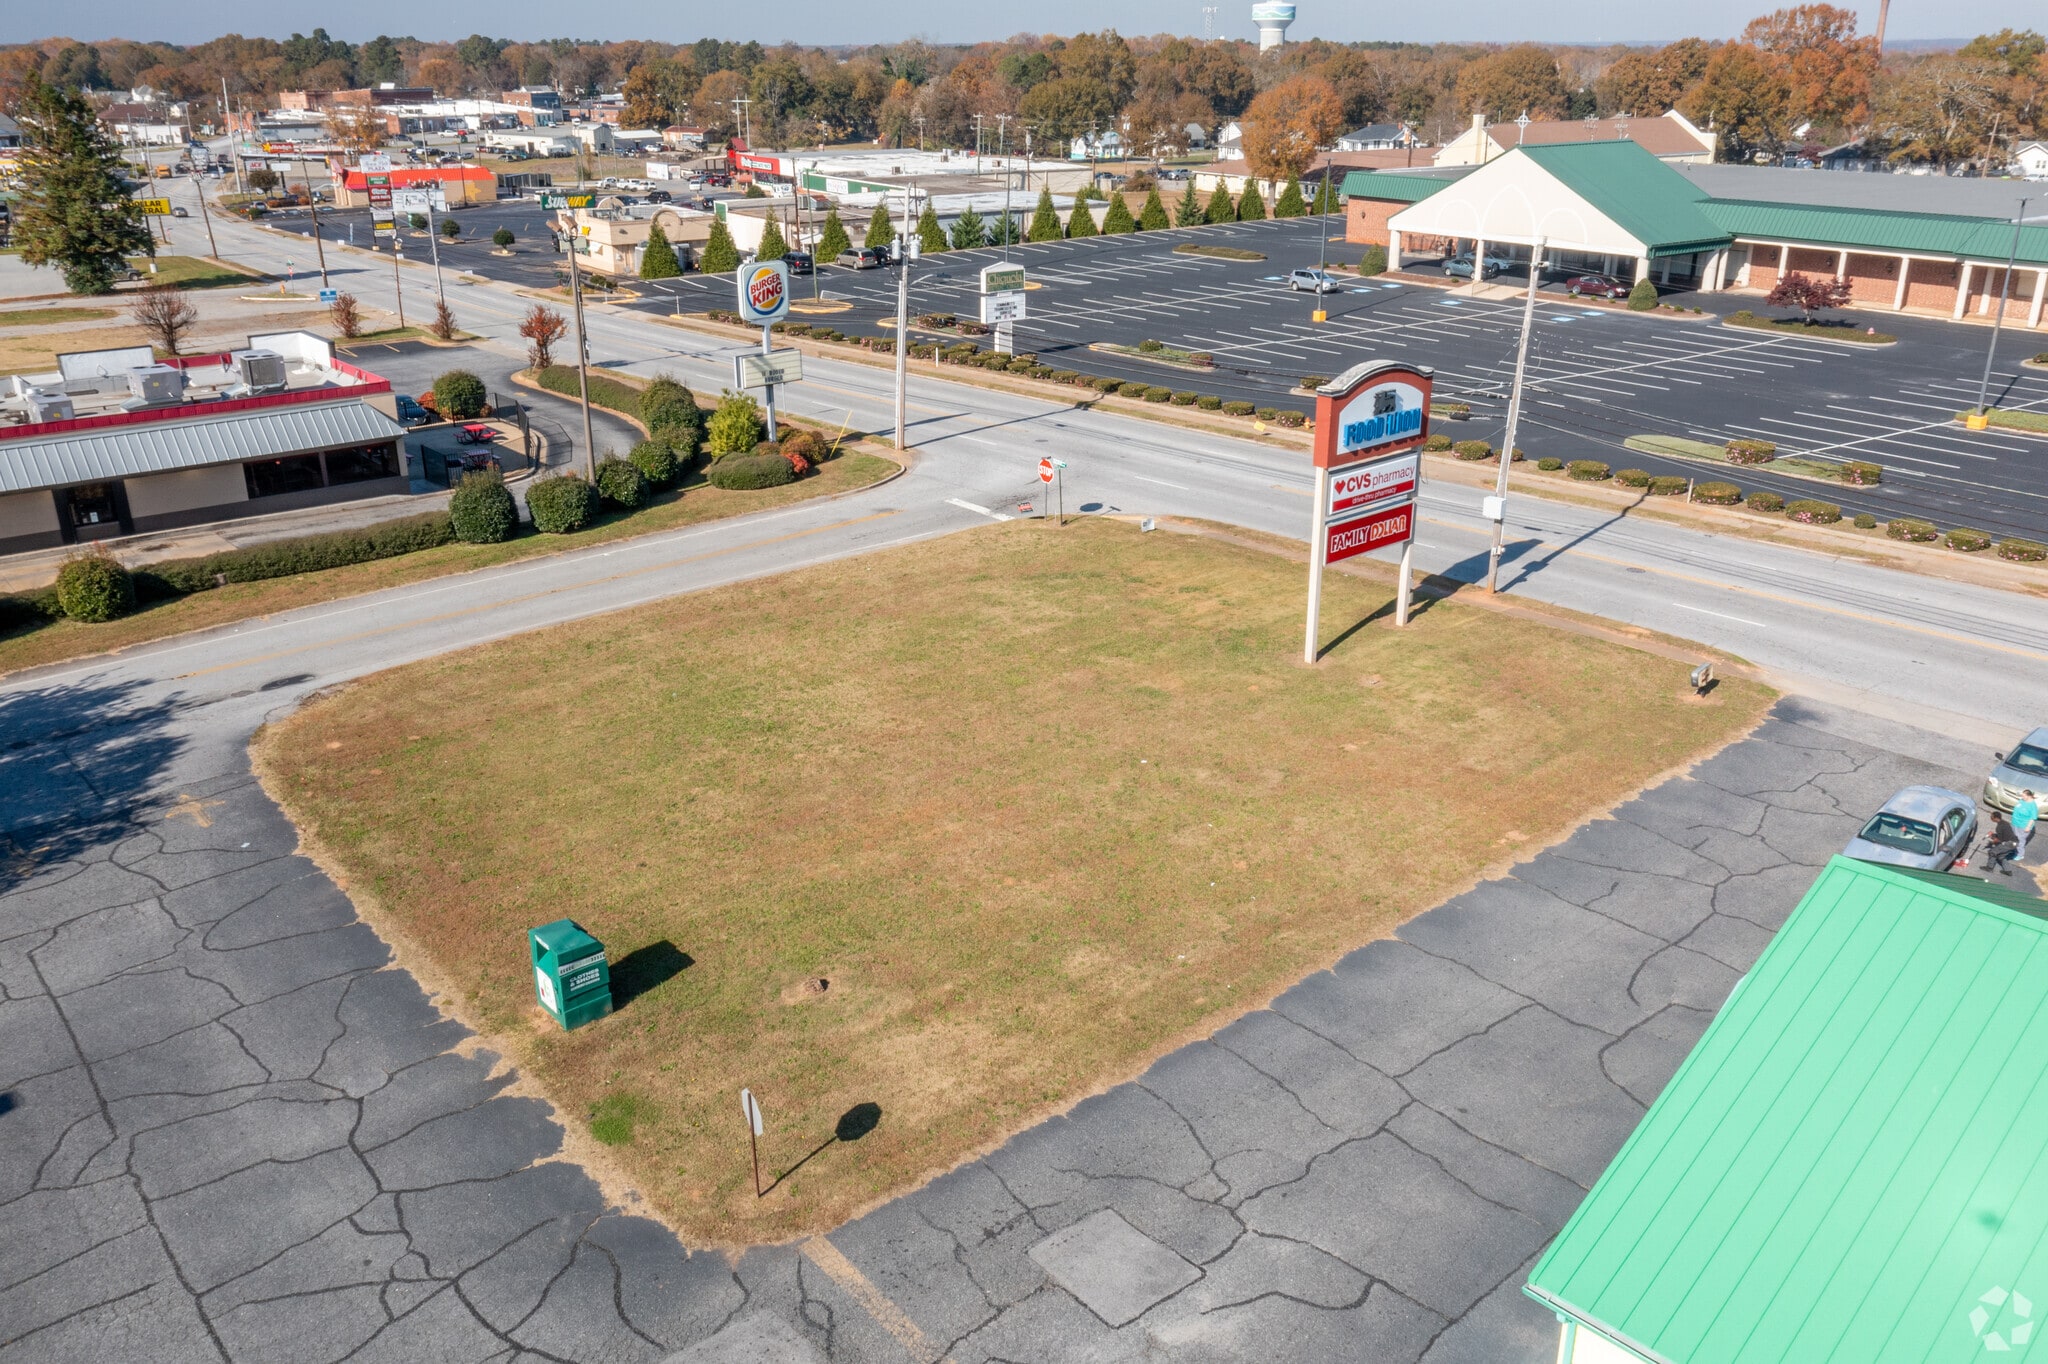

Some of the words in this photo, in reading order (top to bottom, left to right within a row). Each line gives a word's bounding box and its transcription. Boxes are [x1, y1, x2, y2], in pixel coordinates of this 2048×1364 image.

[545, 195, 592, 208] SUBWAY
[750, 273, 781, 295] BURGER
[752, 282, 783, 308] KING
[1344, 416, 1385, 447] FOOD
[1386, 407, 1421, 436] LION
[1039, 465, 1053, 477] STOP
[1346, 472, 1371, 493] CVS
[1372, 466, 1415, 488] pharmacy
[1352, 493, 1375, 504] drive-thru
[1375, 487, 1397, 500] pharmacy
[1330, 525, 1370, 553] FAMILY
[1370, 515, 1407, 541] DOLLAR
